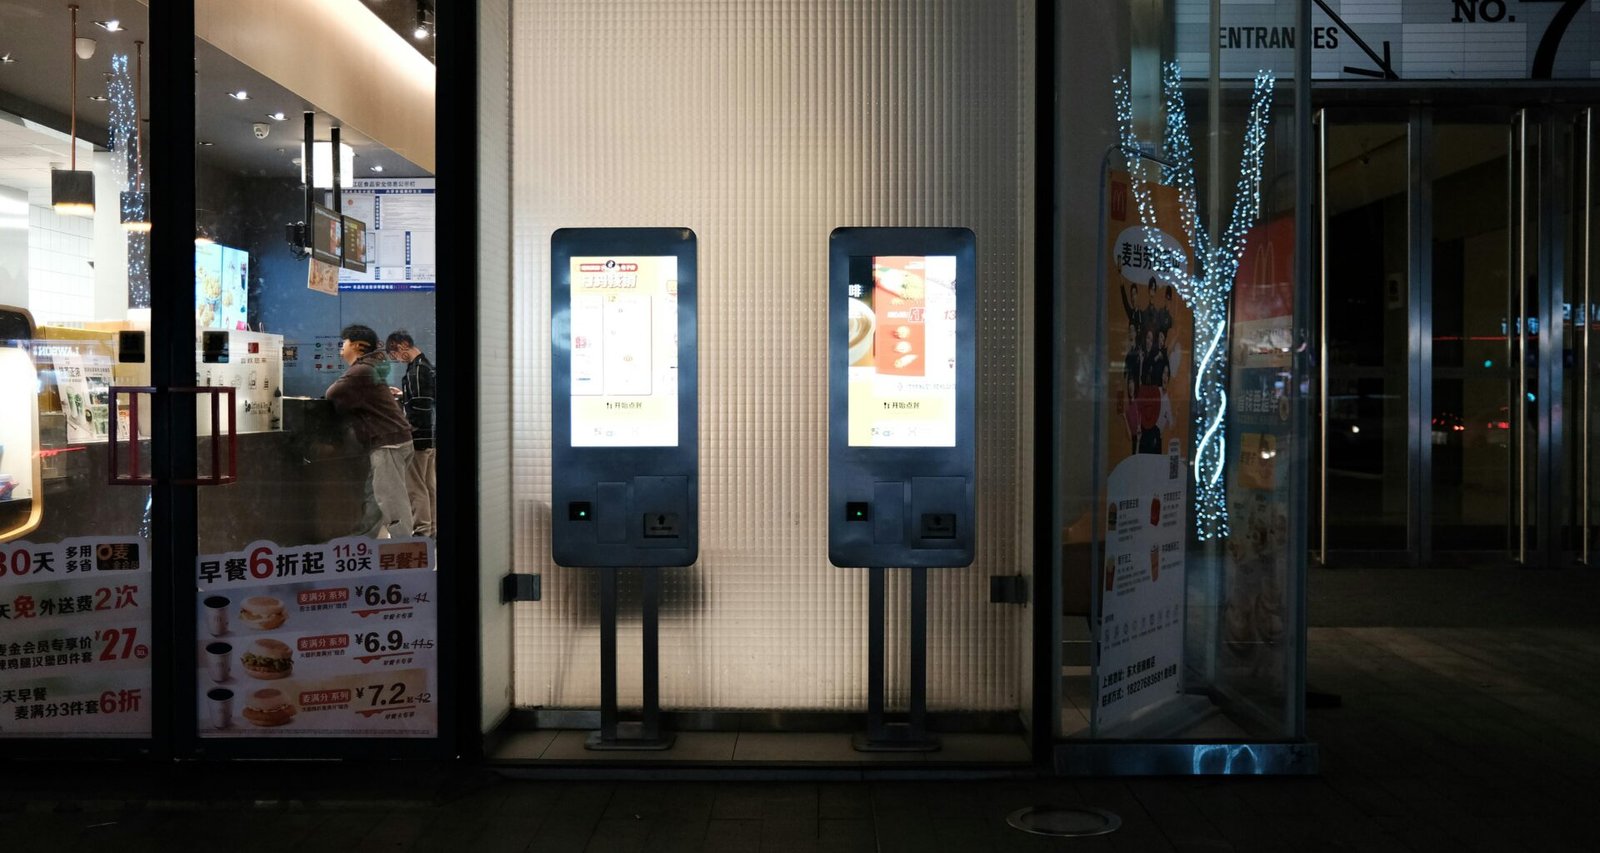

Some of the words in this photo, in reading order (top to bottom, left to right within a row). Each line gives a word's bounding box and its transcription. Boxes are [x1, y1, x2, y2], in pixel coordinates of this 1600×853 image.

[1451, 0, 1516, 23] NO.
[1218, 26, 1339, 49] ENTRANES
[65, 545, 92, 560] 多用
[65, 559, 92, 573] 多省
[199, 547, 325, 584] 早餐6折起
[335, 557, 372, 572] 30天
[0, 687, 47, 704] 天早餐
